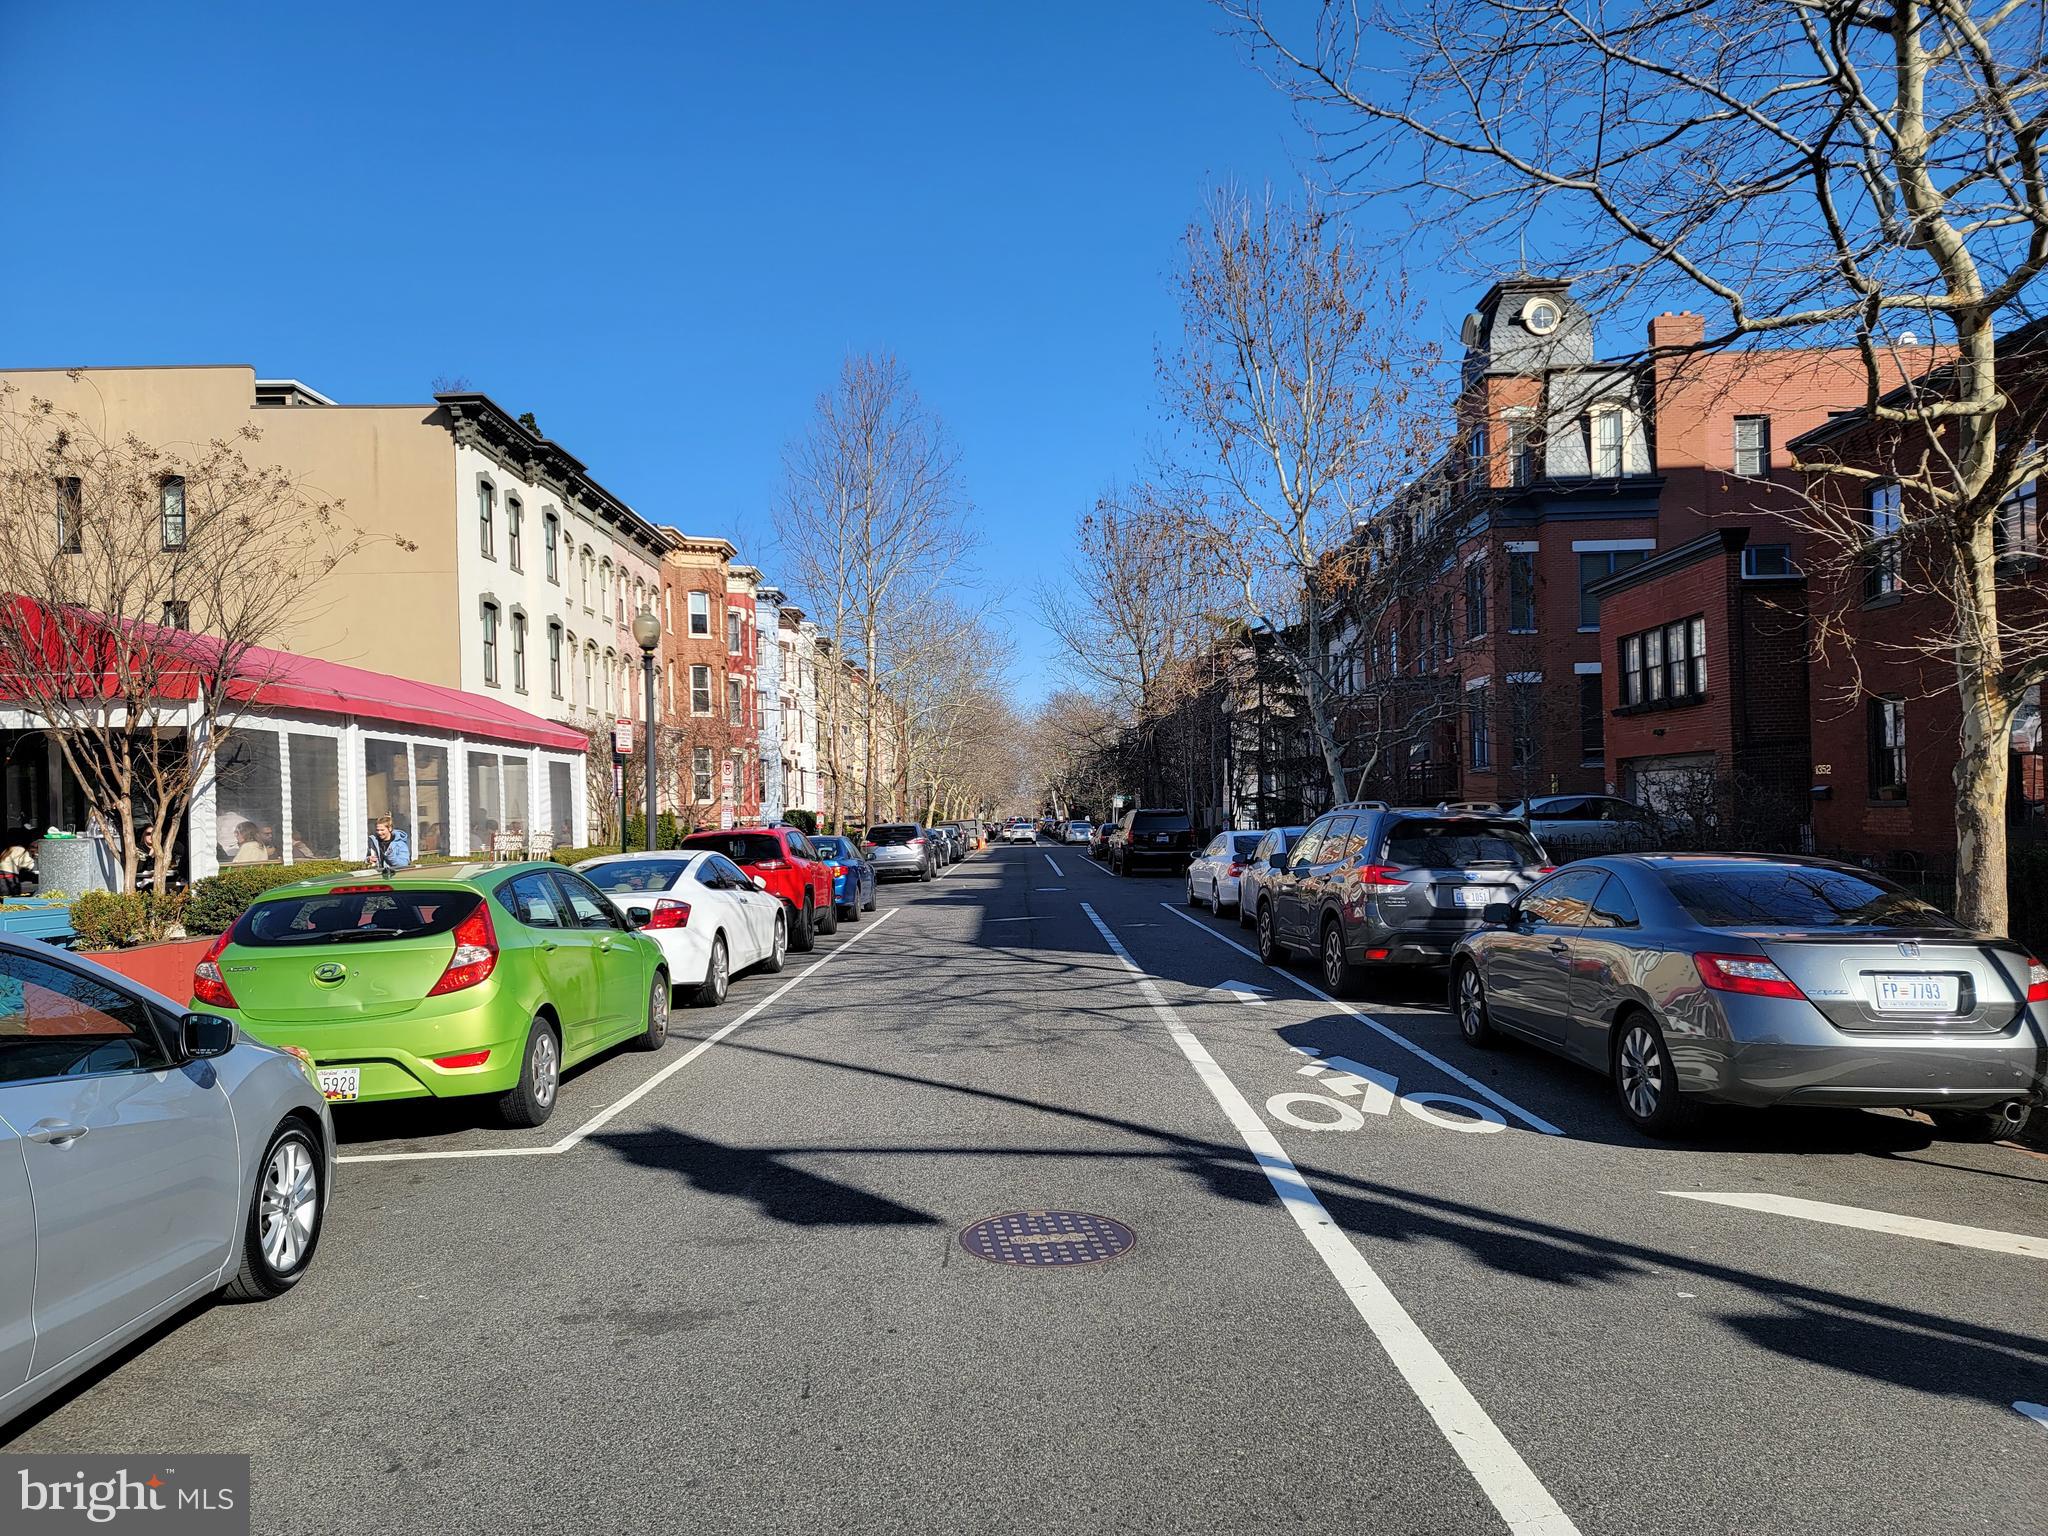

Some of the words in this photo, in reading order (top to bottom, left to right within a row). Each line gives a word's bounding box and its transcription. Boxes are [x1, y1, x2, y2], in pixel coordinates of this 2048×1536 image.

[1815, 764, 1832, 775] 1352
[1882, 983, 1898, 999] FP
[1910, 983, 1941, 999] 7793
[323, 1076, 355, 1093] 5928
